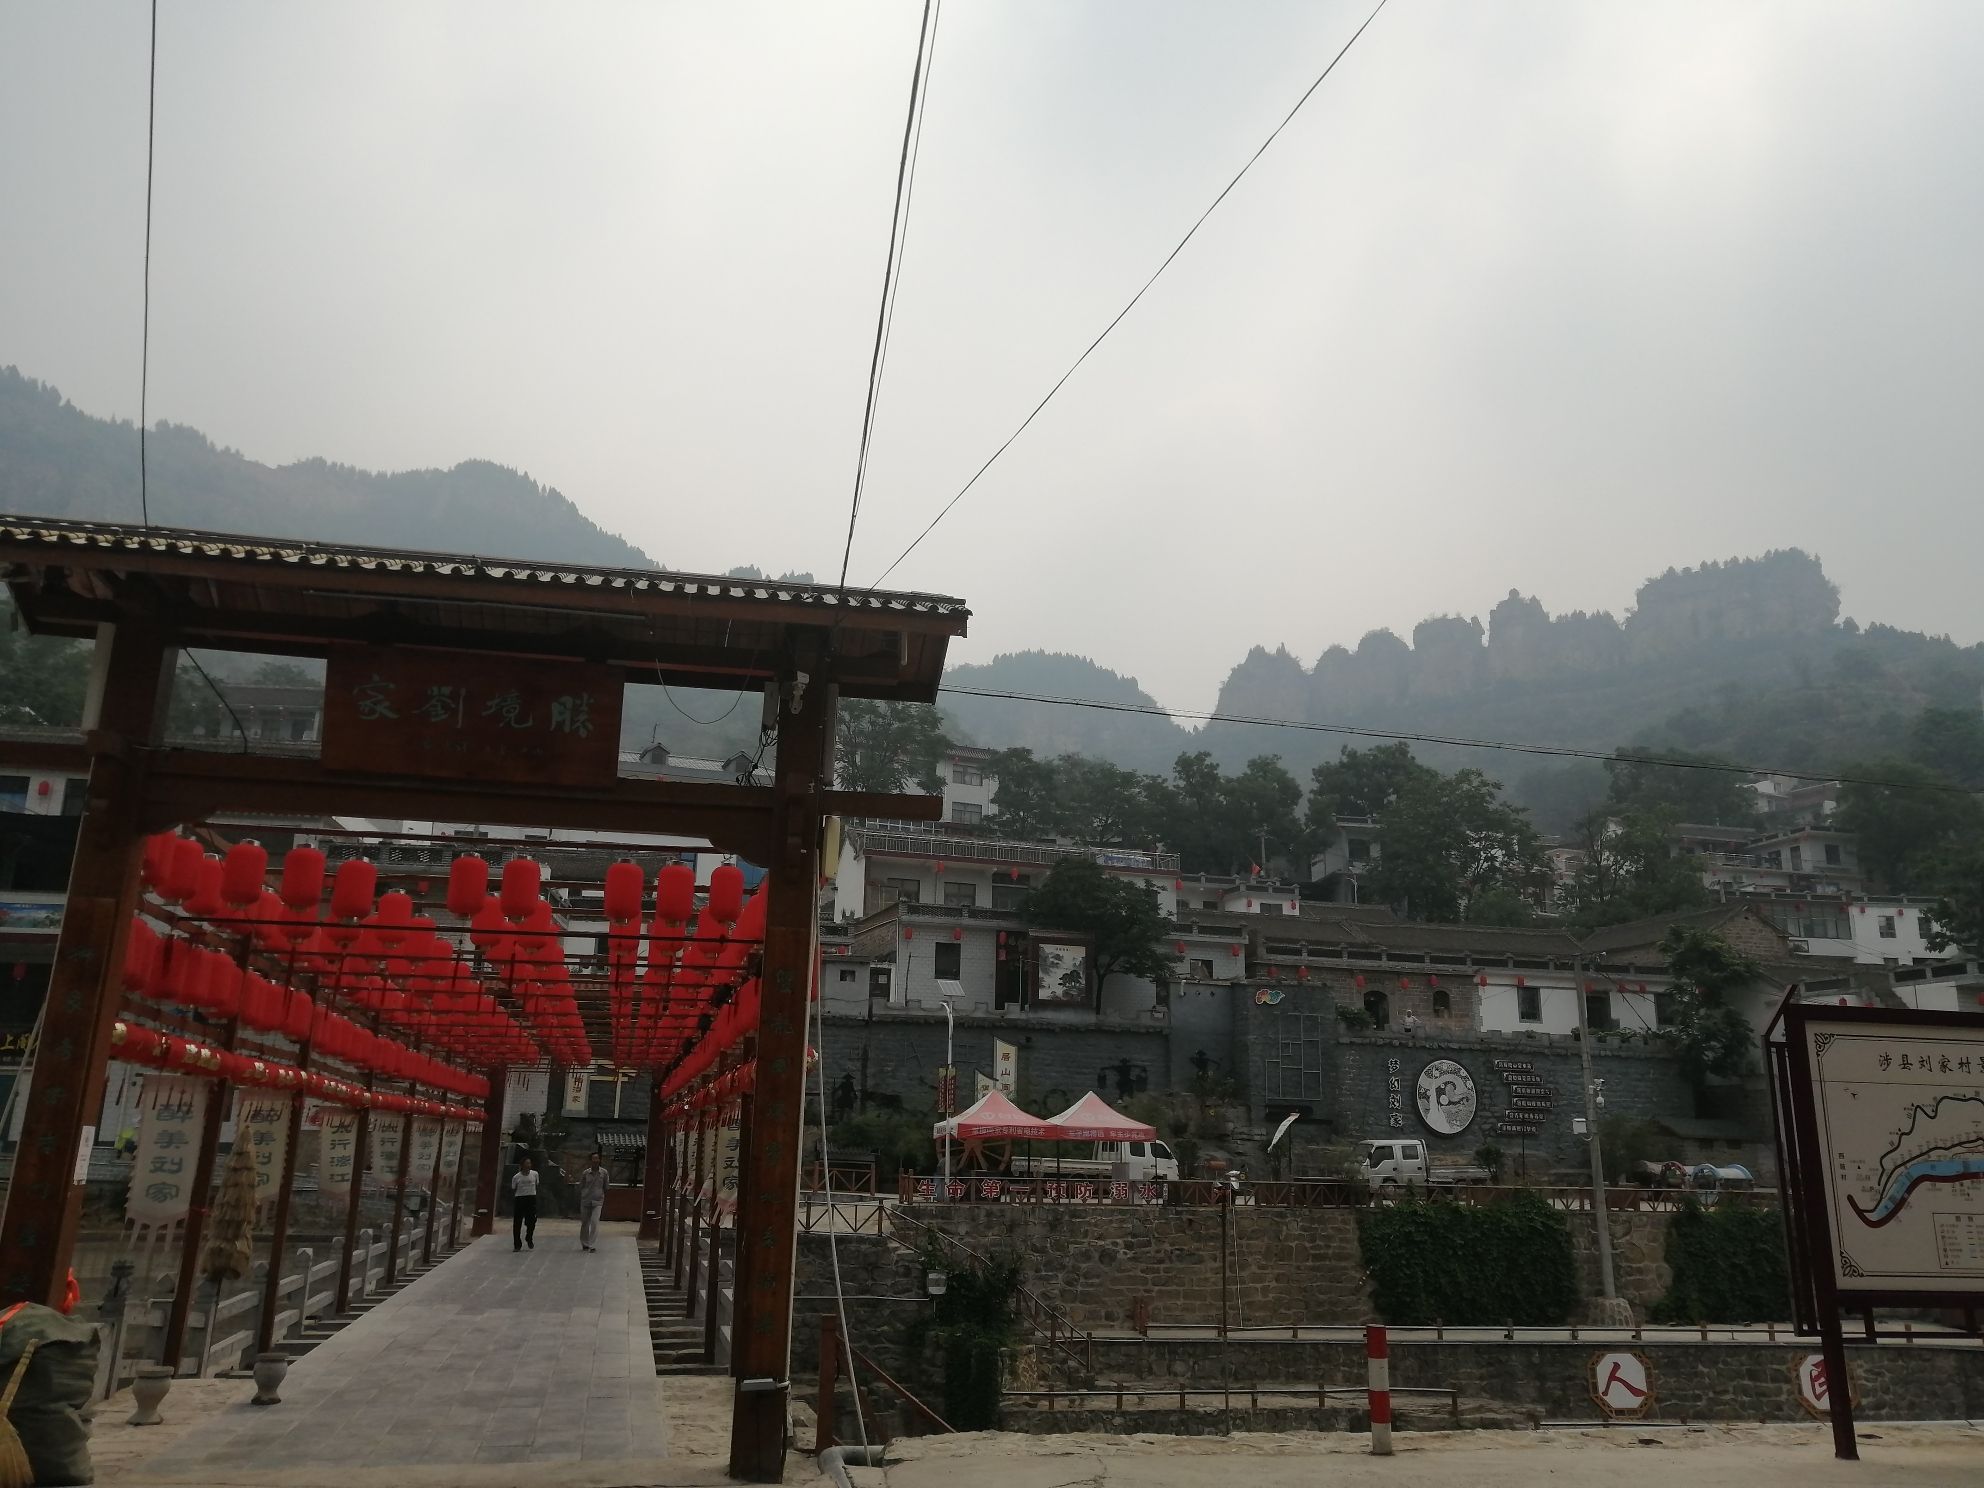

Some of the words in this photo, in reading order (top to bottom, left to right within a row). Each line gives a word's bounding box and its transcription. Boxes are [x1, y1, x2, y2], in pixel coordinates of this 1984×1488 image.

[1387, 1058, 1403, 1127] 梦幻刘家
[145, 1103, 193, 1203] 醉美刘家
[1601, 1361, 1647, 1397] 人
